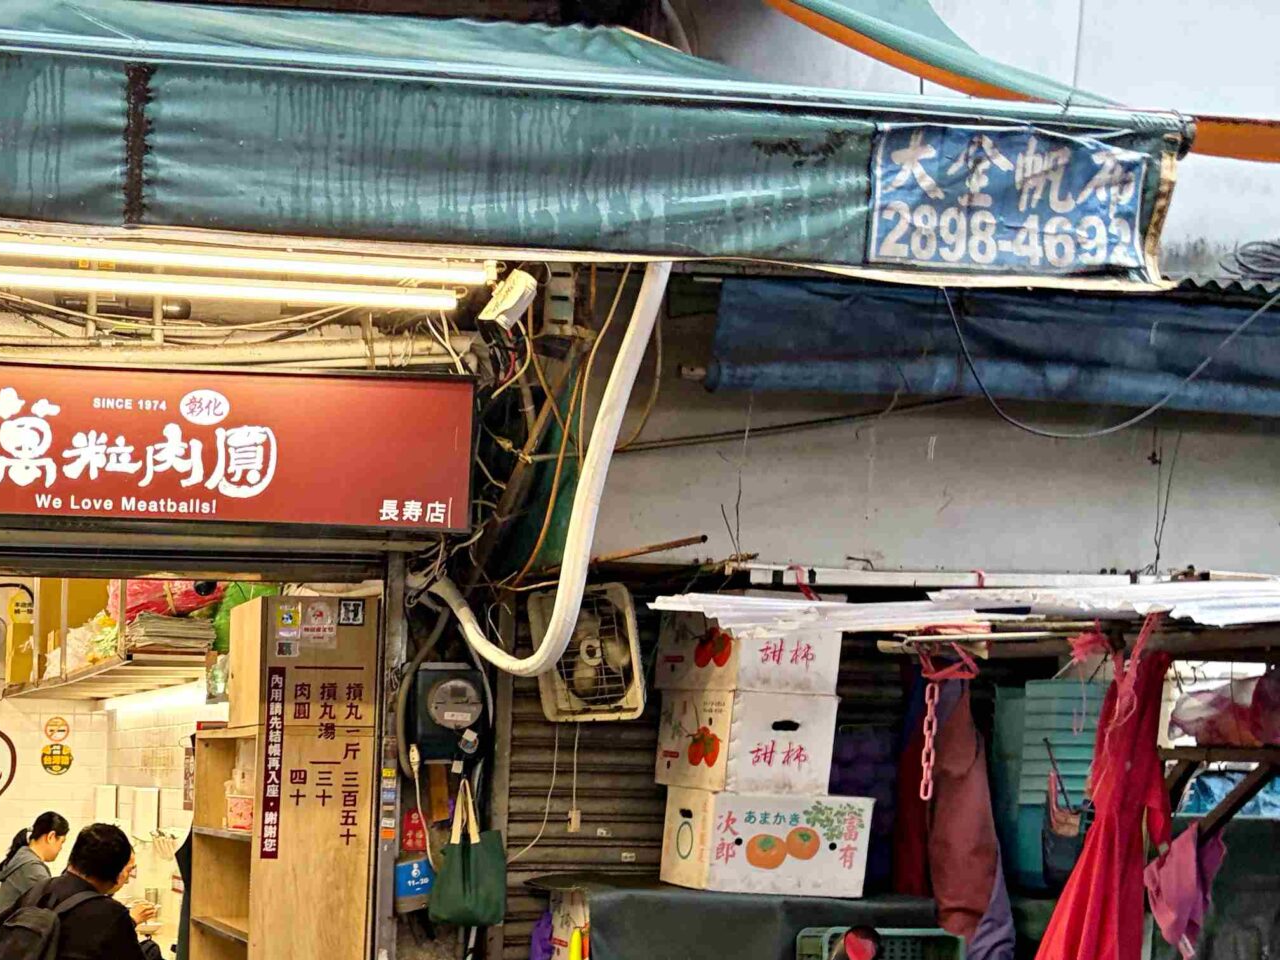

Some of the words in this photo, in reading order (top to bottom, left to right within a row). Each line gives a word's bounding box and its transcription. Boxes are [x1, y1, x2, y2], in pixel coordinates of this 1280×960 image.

[92, 397, 133, 410] SINCE
[137, 399, 167, 411] 1974
[185, 396, 224, 417] 彰化
[34, 493, 62, 510] We
[70, 494, 114, 511] Love
[121, 496, 218, 514] Meatballs!
[759, 638, 816, 670] 甜柿
[293, 682, 311, 719] 肉圓
[750, 739, 808, 771] 甜柿
[289, 769, 307, 806] 四十
[743, 810, 800, 826] あまかき
